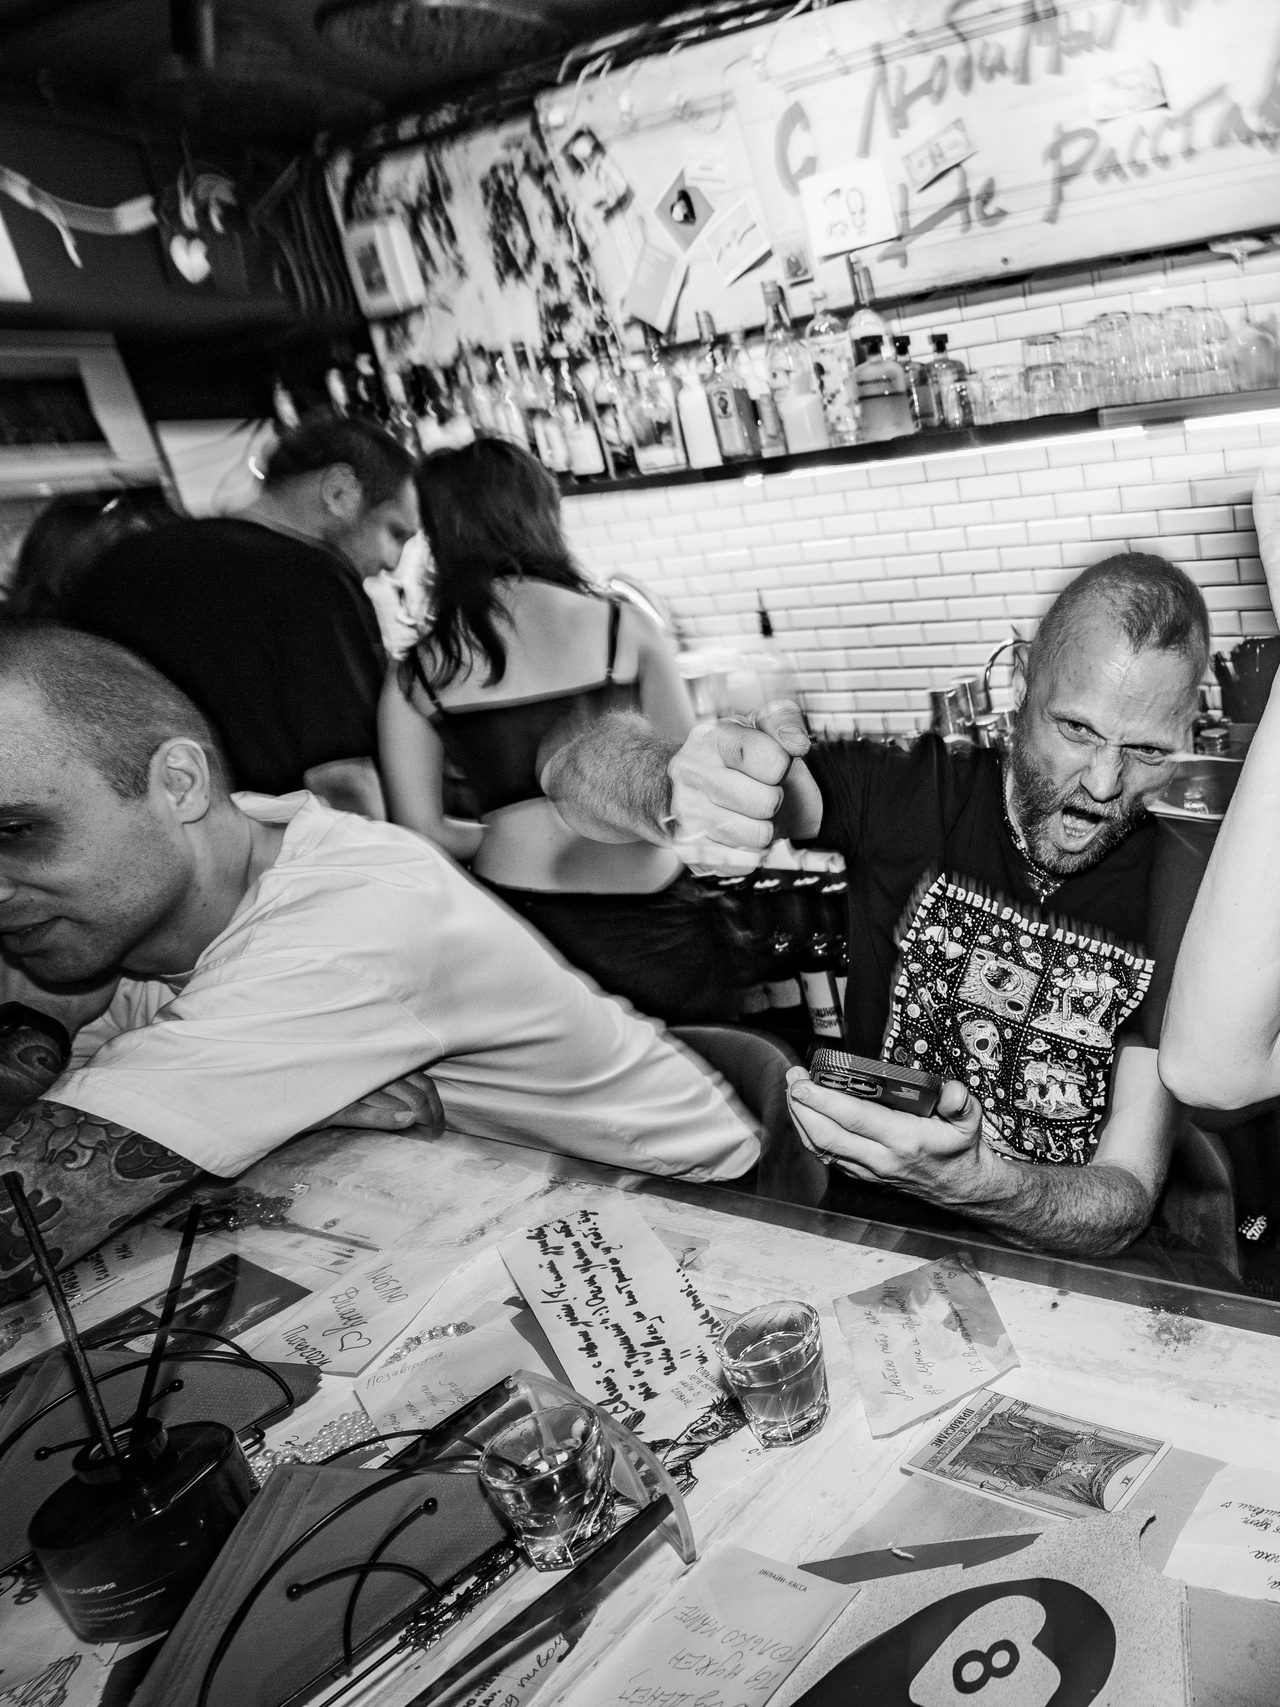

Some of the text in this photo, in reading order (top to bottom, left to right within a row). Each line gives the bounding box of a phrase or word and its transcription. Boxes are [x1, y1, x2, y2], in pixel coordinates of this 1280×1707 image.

[1000, 907, 1050, 938] SPACE
[1052, 928, 1156, 974] ADVENTURE
[364, 1264, 408, 1303] Люблю
[322, 1287, 368, 1346] Диану
[864, 1311, 880, 1325] как
[880, 1360, 914, 1401] Люблю
[923, 1385, 945, 1395] до
[930, 1406, 975, 1449] ПРАВОСУДИЕ
[653, 1596, 804, 1669] ТОЛЬКО МАМЕ!
[668, 1648, 780, 1697] ТЫ НУЖЕН
[952, 1639, 1020, 1694] 8
